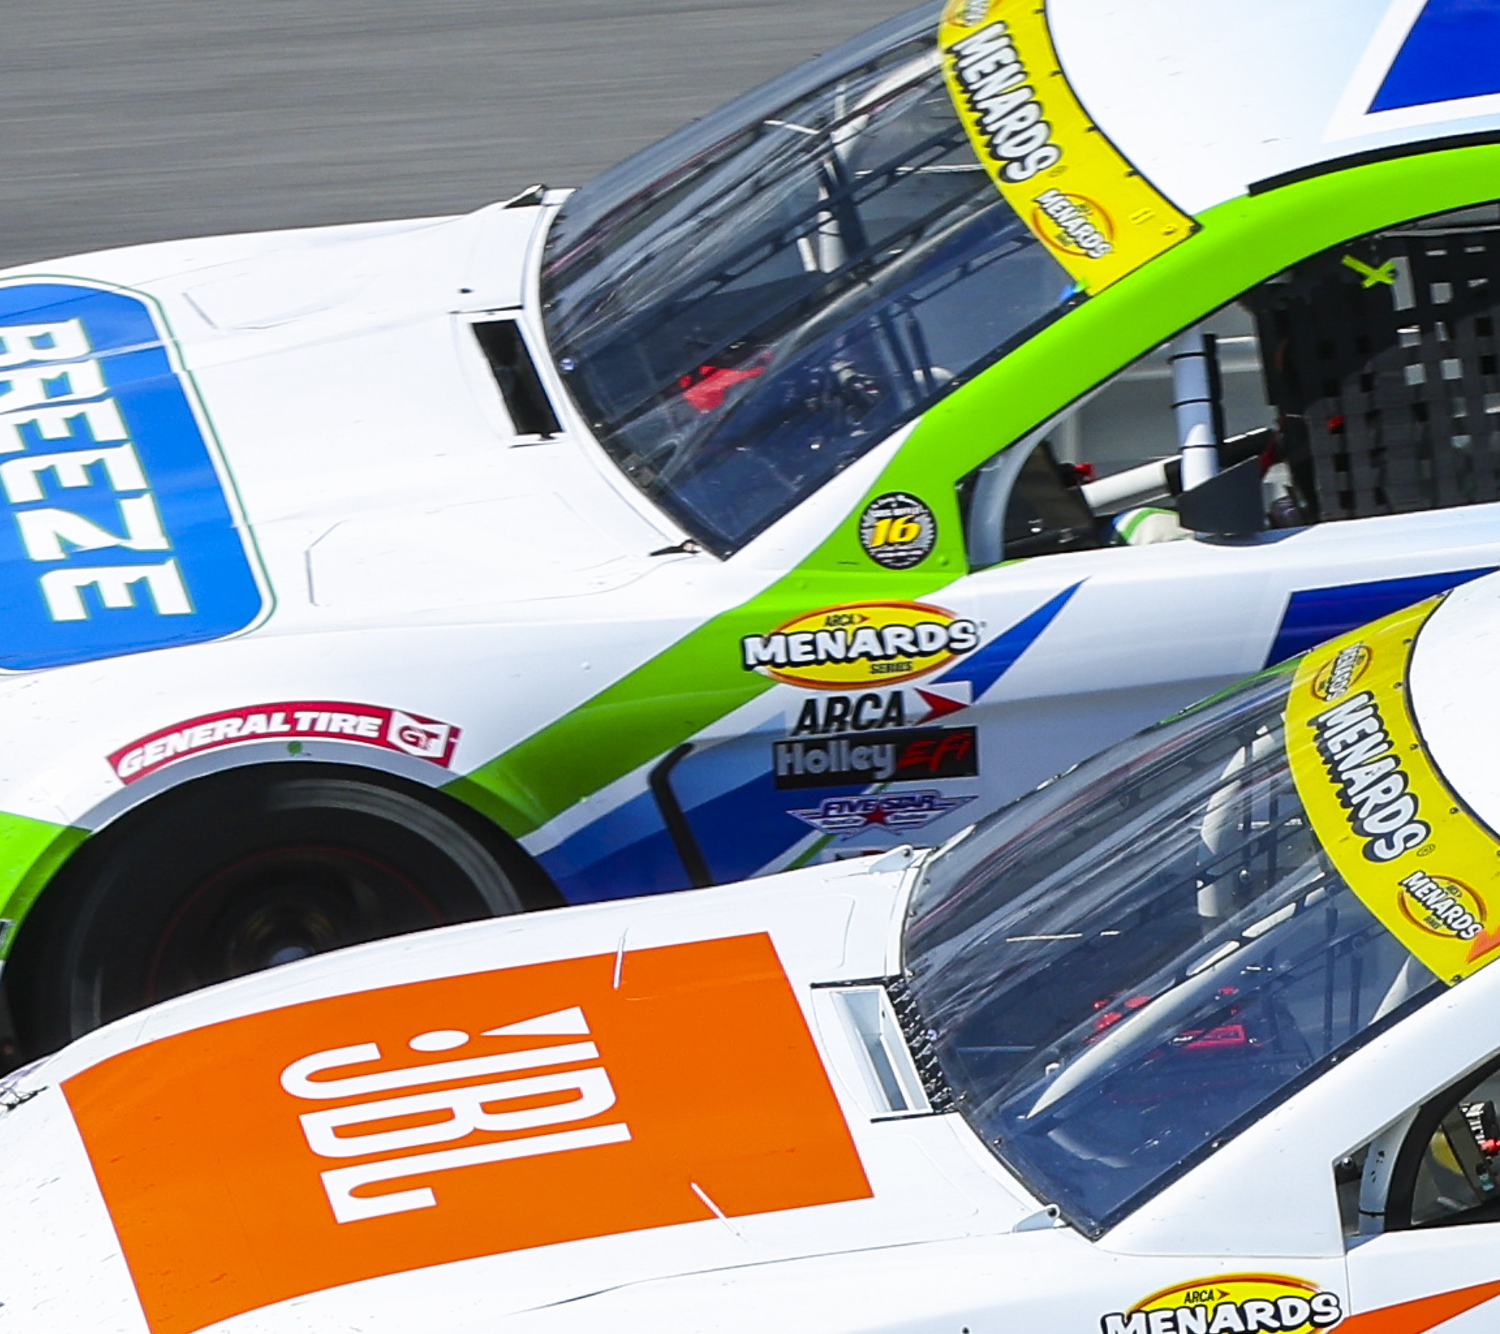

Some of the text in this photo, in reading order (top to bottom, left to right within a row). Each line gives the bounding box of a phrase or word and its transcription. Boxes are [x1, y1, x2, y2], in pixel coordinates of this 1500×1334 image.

[949, 20, 1062, 181] MENARDS
[1033, 188, 1113, 259] MENARDS
[871, 515, 921, 547] 16
[743, 620, 980, 669] MENARDS
[117, 711, 384, 779] GENERAL TIRE
[790, 690, 905, 737] ARCA
[775, 739, 897, 780] Holley
[1317, 691, 1430, 861] MENARDS
[1402, 870, 1483, 940] MENARDS
[280, 1005, 632, 1224] JBL
[1184, 1289, 1216, 1305] ARCA
